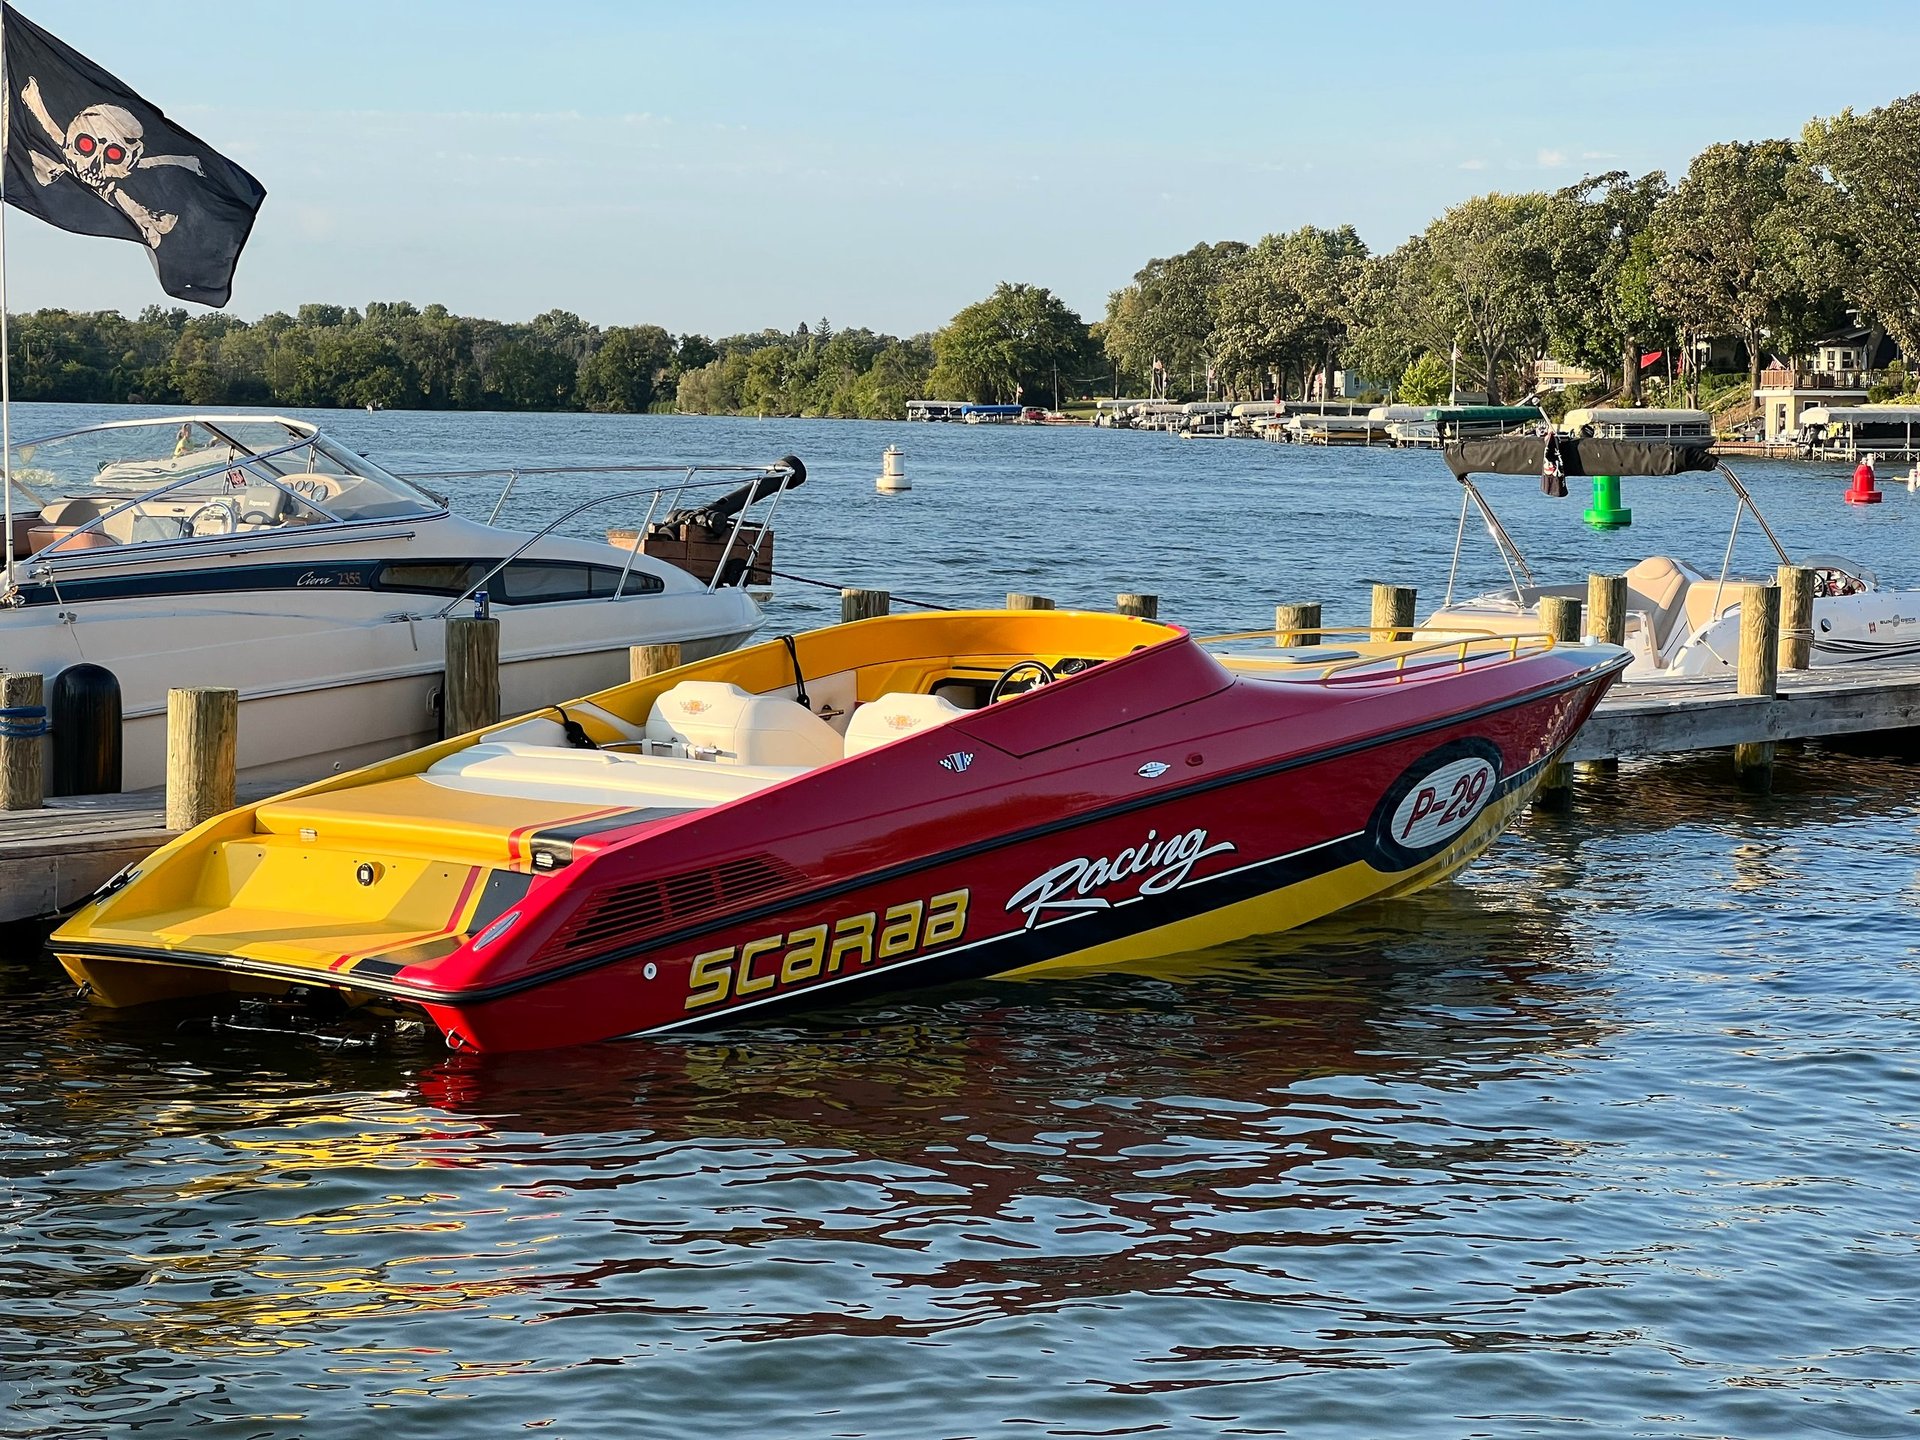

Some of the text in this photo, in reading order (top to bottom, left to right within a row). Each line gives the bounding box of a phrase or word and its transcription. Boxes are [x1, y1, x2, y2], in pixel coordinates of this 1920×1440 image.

[296, 571, 361, 586] Ciera 2355
[1401, 767, 1489, 839] P-29
[1005, 828, 1236, 929] Racing
[684, 888, 969, 1009] SCARAB
